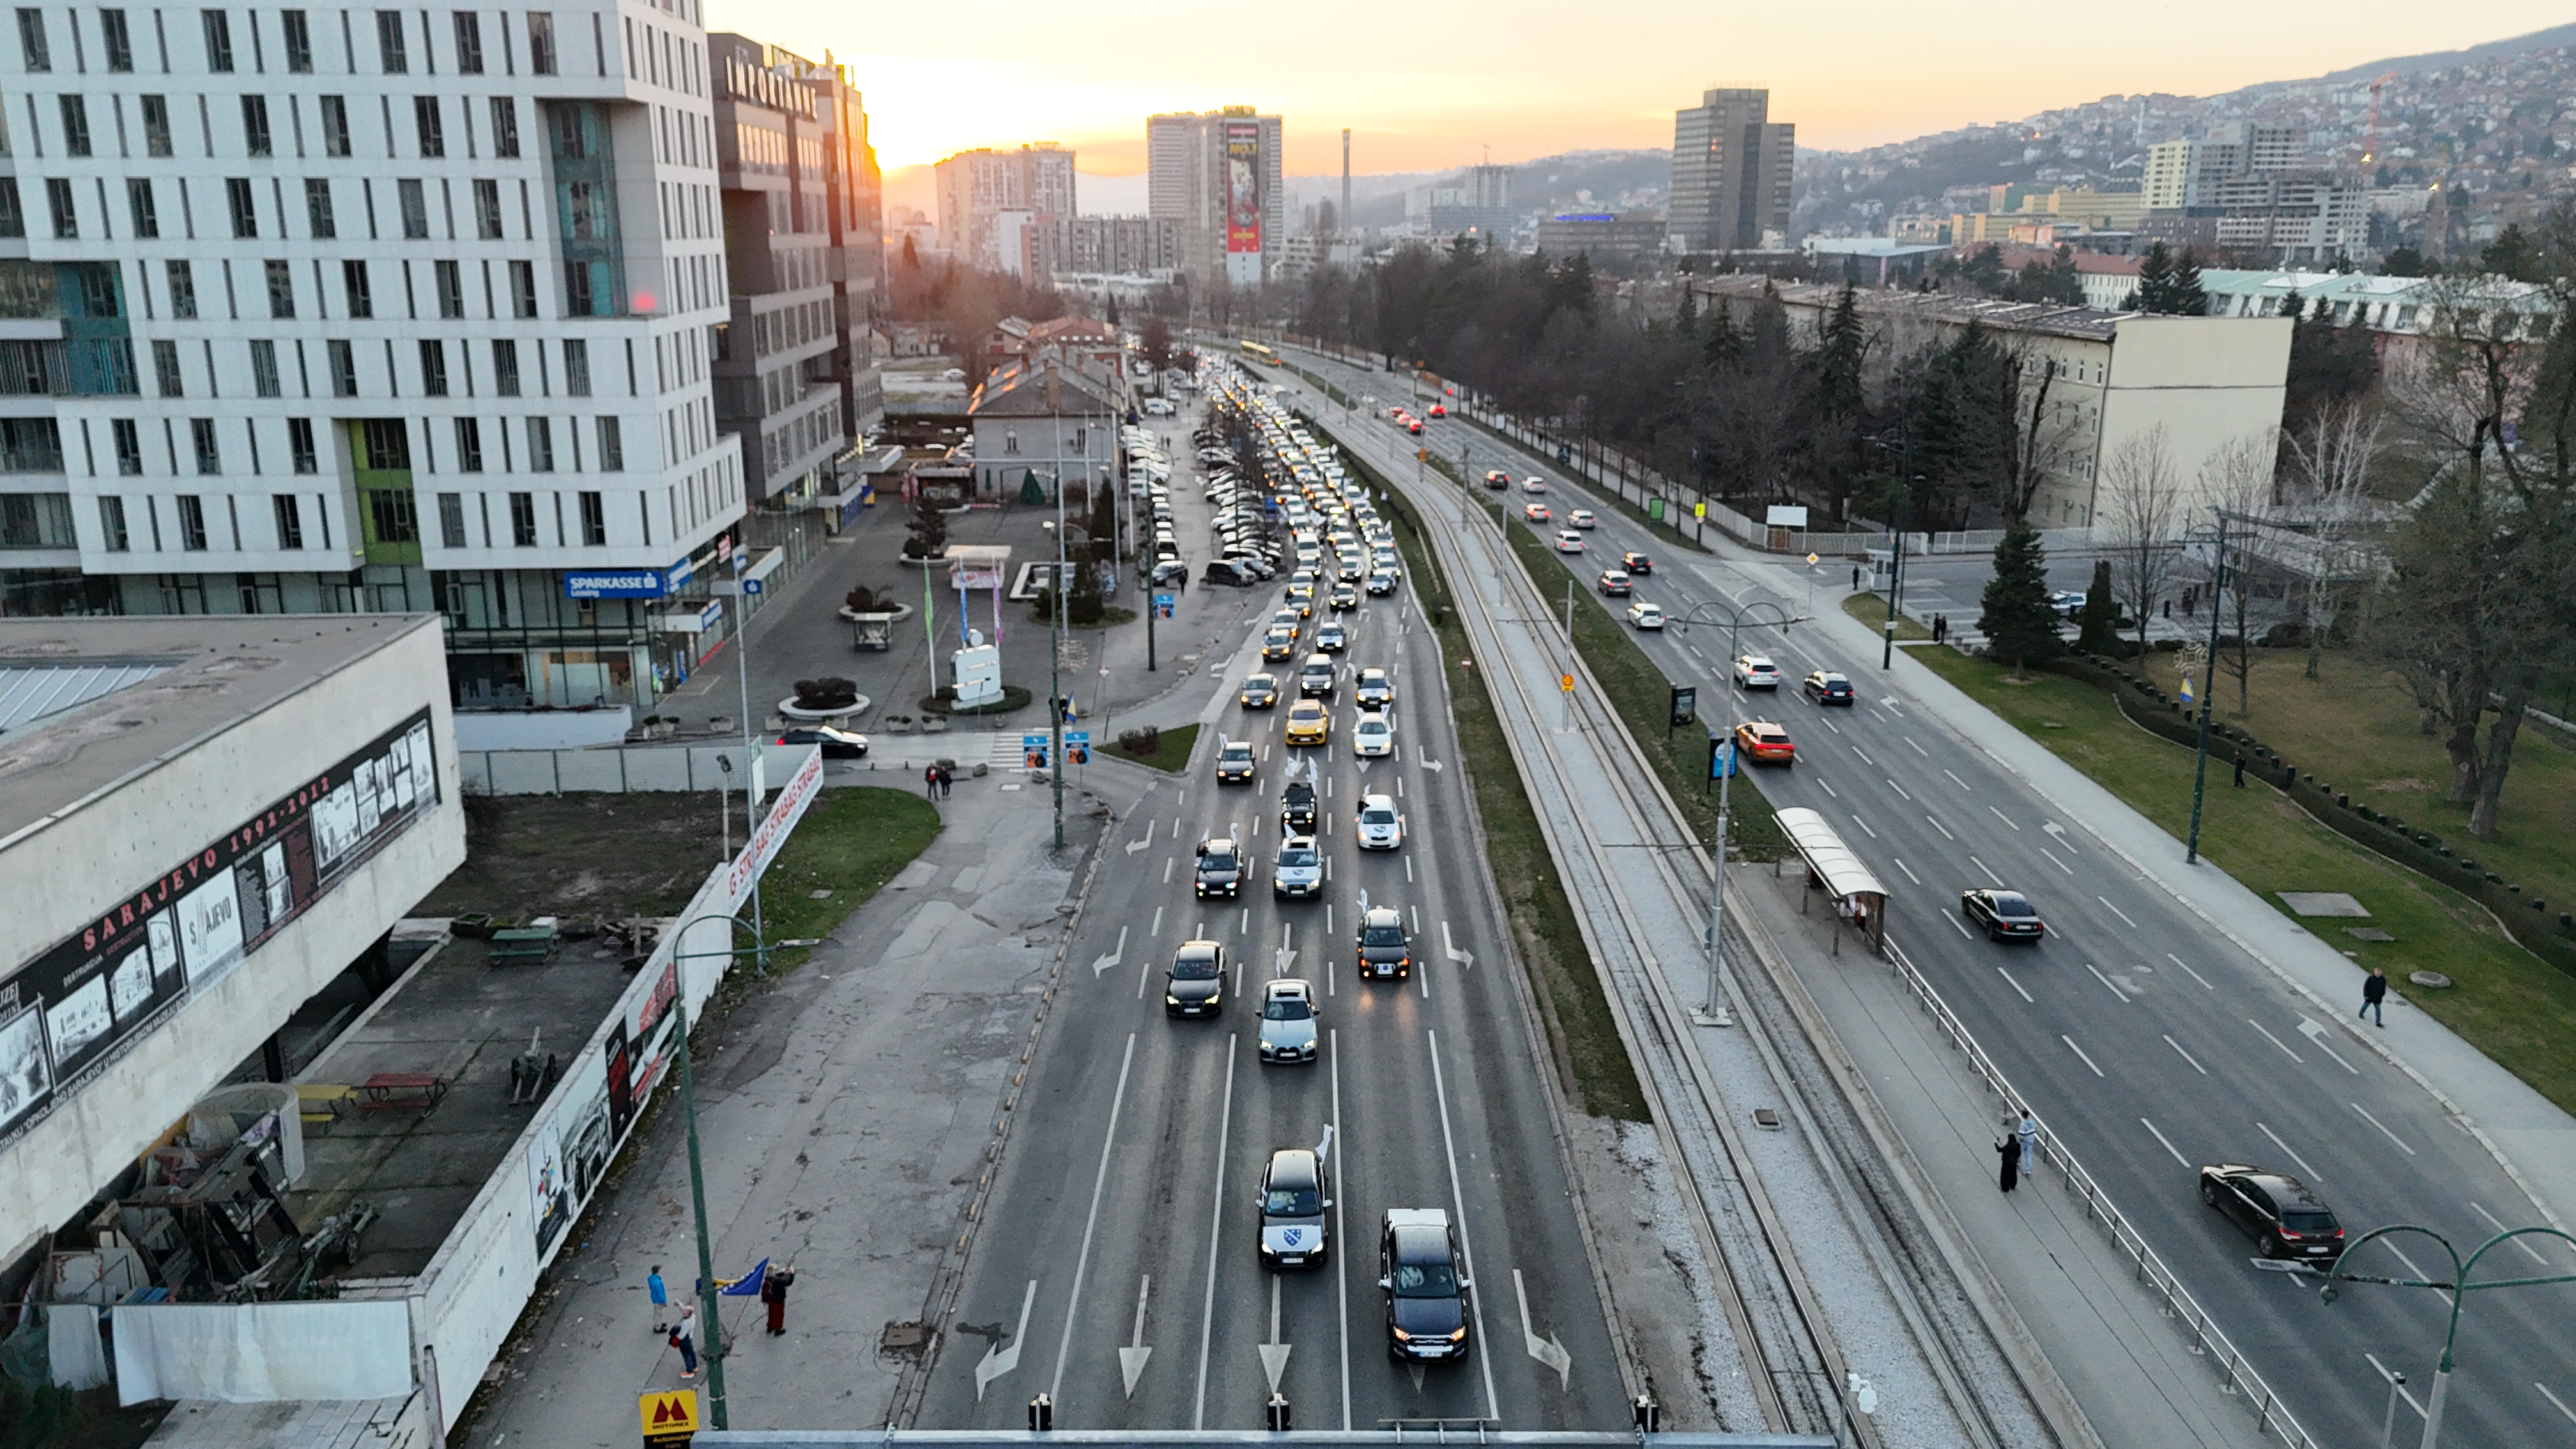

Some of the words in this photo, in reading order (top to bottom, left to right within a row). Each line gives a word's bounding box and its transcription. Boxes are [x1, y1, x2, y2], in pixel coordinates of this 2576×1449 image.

[726, 55, 818, 119] IMPORTANNE
[570, 576, 643, 589] SPARKASSE
[83, 848, 217, 952] SARAJEVO
[230, 776, 329, 853] 1992-2012
[103, 1055, 109, 1069] U
